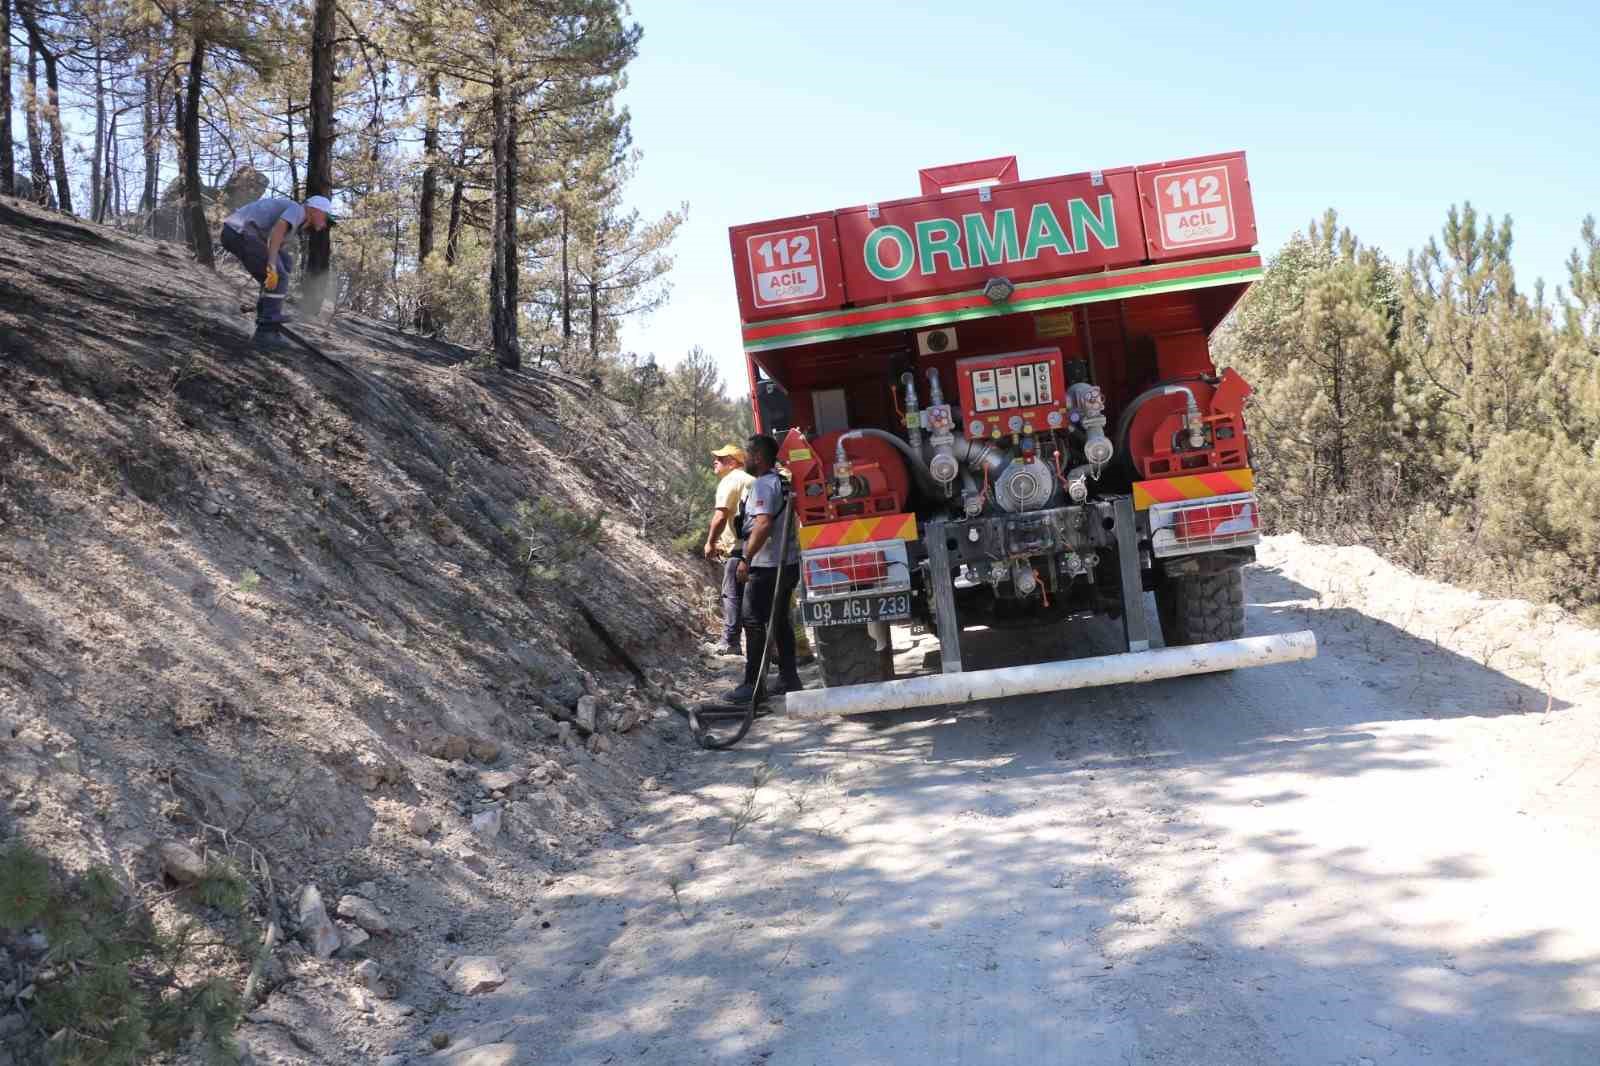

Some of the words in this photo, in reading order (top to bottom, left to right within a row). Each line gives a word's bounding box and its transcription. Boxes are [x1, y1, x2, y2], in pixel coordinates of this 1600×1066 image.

[1165, 175, 1222, 208] 112
[1178, 210, 1217, 229] ACİL
[757, 235, 812, 268] 112
[863, 194, 1119, 282] ORMAN
[769, 270, 808, 288] ACİL
[813, 603, 832, 620] 03
[843, 599, 871, 618] AGJ
[879, 597, 906, 615] 233
